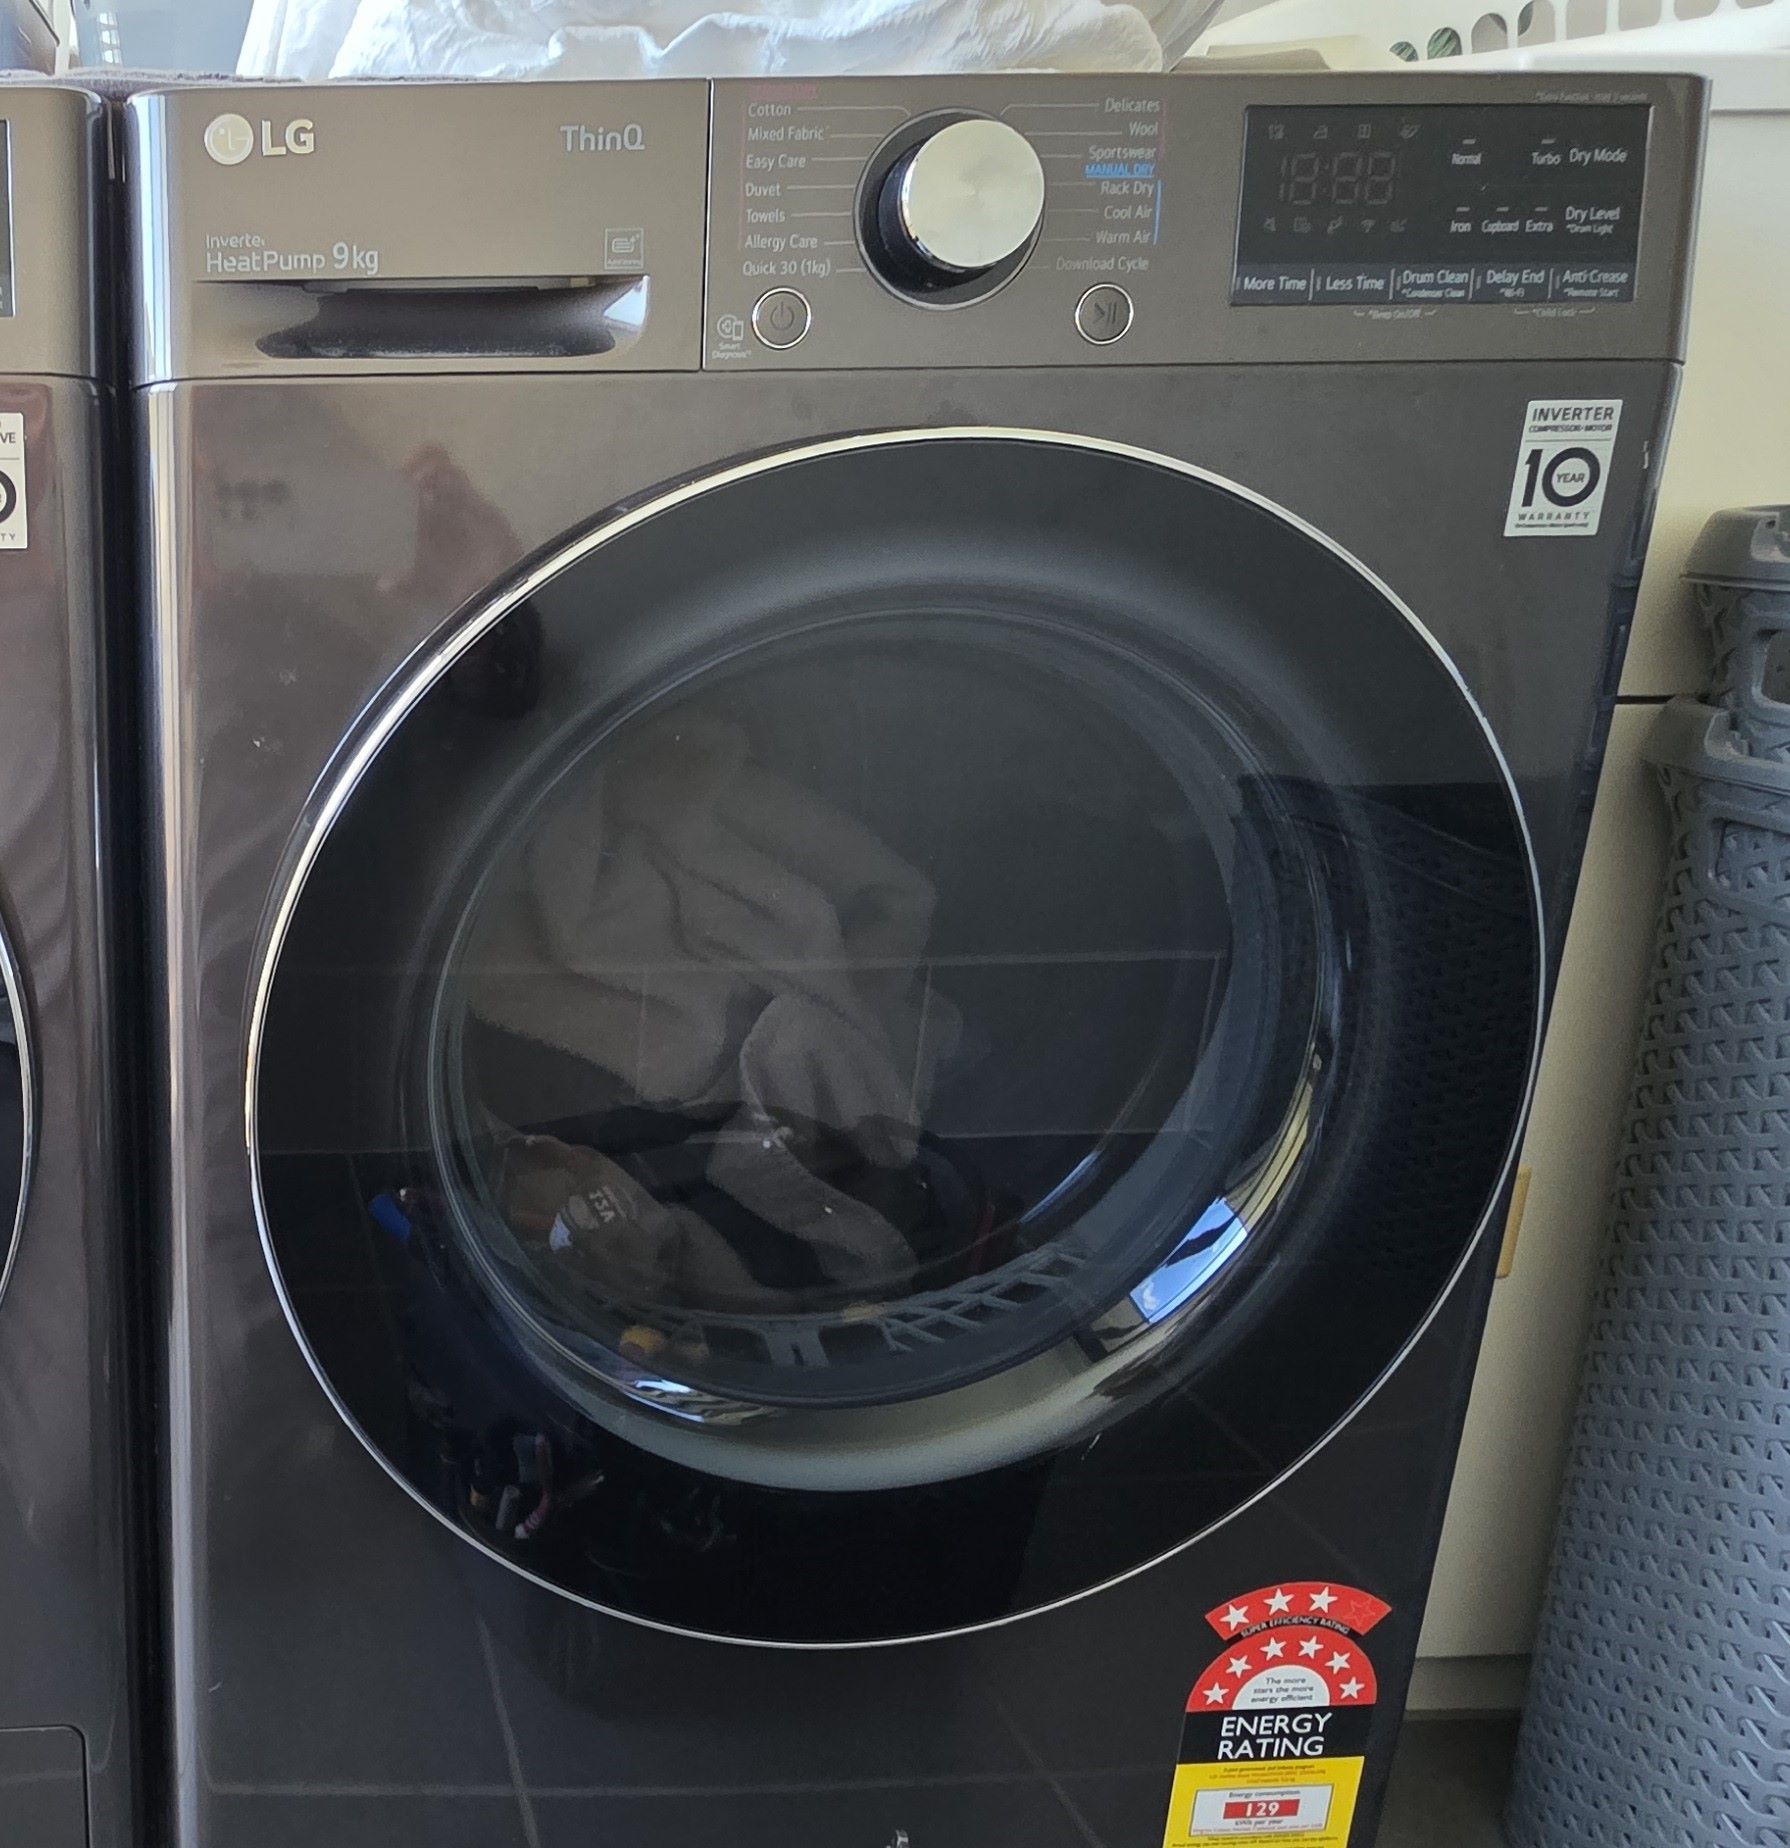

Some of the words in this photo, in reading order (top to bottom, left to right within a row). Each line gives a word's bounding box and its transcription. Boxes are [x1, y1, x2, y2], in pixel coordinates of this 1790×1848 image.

[747, 102, 792, 118] Cotton
[1104, 97, 1161, 113] Delicates
[261, 118, 316, 156] LG
[747, 126, 785, 141] Mixed
[1128, 121, 1159, 137] Wool
[559, 123, 647, 152] ThinQ
[1088, 145, 1157, 162] Sportswear
[1451, 152, 1483, 166] Normal
[1531, 152, 1562, 166] Turbo
[1569, 147, 1591, 167] Dry
[1593, 148, 1629, 164] Mode
[745, 153, 776, 172] Easy
[777, 153, 807, 168] Care
[745, 182, 781, 197] Duvet
[1101, 180, 1131, 195] Rack
[1133, 180, 1155, 198] Dry
[745, 208, 786, 223] Towels
[1103, 205, 1133, 220] Cool
[1134, 204, 1153, 219] Air
[1565, 206, 1588, 224] Dry
[1589, 206, 1621, 221] Level
[1450, 220, 1472, 234] Iron
[1524, 220, 1554, 234] Extra
[744, 233, 786, 253] Allergy
[788, 233, 819, 249] Care
[1095, 230, 1131, 245] Warm
[1132, 230, 1152, 244] Air
[742, 260, 777, 277] Quick
[779, 260, 798, 275] 30
[800, 258, 831, 279] (1kg)
[1055, 256, 1116, 272] Download
[1117, 256, 1150, 273] Cycle
[1243, 276, 1276, 291] More
[1278, 275, 1308, 291] Time
[1325, 275, 1353, 291] Less
[1355, 275, 1385, 291] Time
[1402, 269, 1435, 285] Drum
[1436, 269, 1469, 285] Clean
[1486, 269, 1518, 287] Delay
[1521, 269, 1546, 285] End
[1532, 406, 1615, 422] INVERTER
[1522, 447, 1600, 507] 10
[1556, 472, 1585, 483] YEAR
[1518, 511, 1591, 521] WARRANTY
[1240, 1620, 1269, 1638] SUPER
[1268, 1615, 1318, 1628] EFFICIENCY
[1319, 1616, 1351, 1635] RATING
[1265, 1676, 1282, 1686] The
[1275, 1685, 1290, 1694] the
[1291, 1685, 1315, 1693] more
[1250, 1695, 1279, 1705] energy
[1281, 1693, 1314, 1703] efficient
[1220, 1712, 1333, 1738] ENERGY
[1216, 1735, 1326, 1761] RATING
[1228, 1791, 1253, 1801] Energy
[1245, 1801, 1280, 1818] 129
